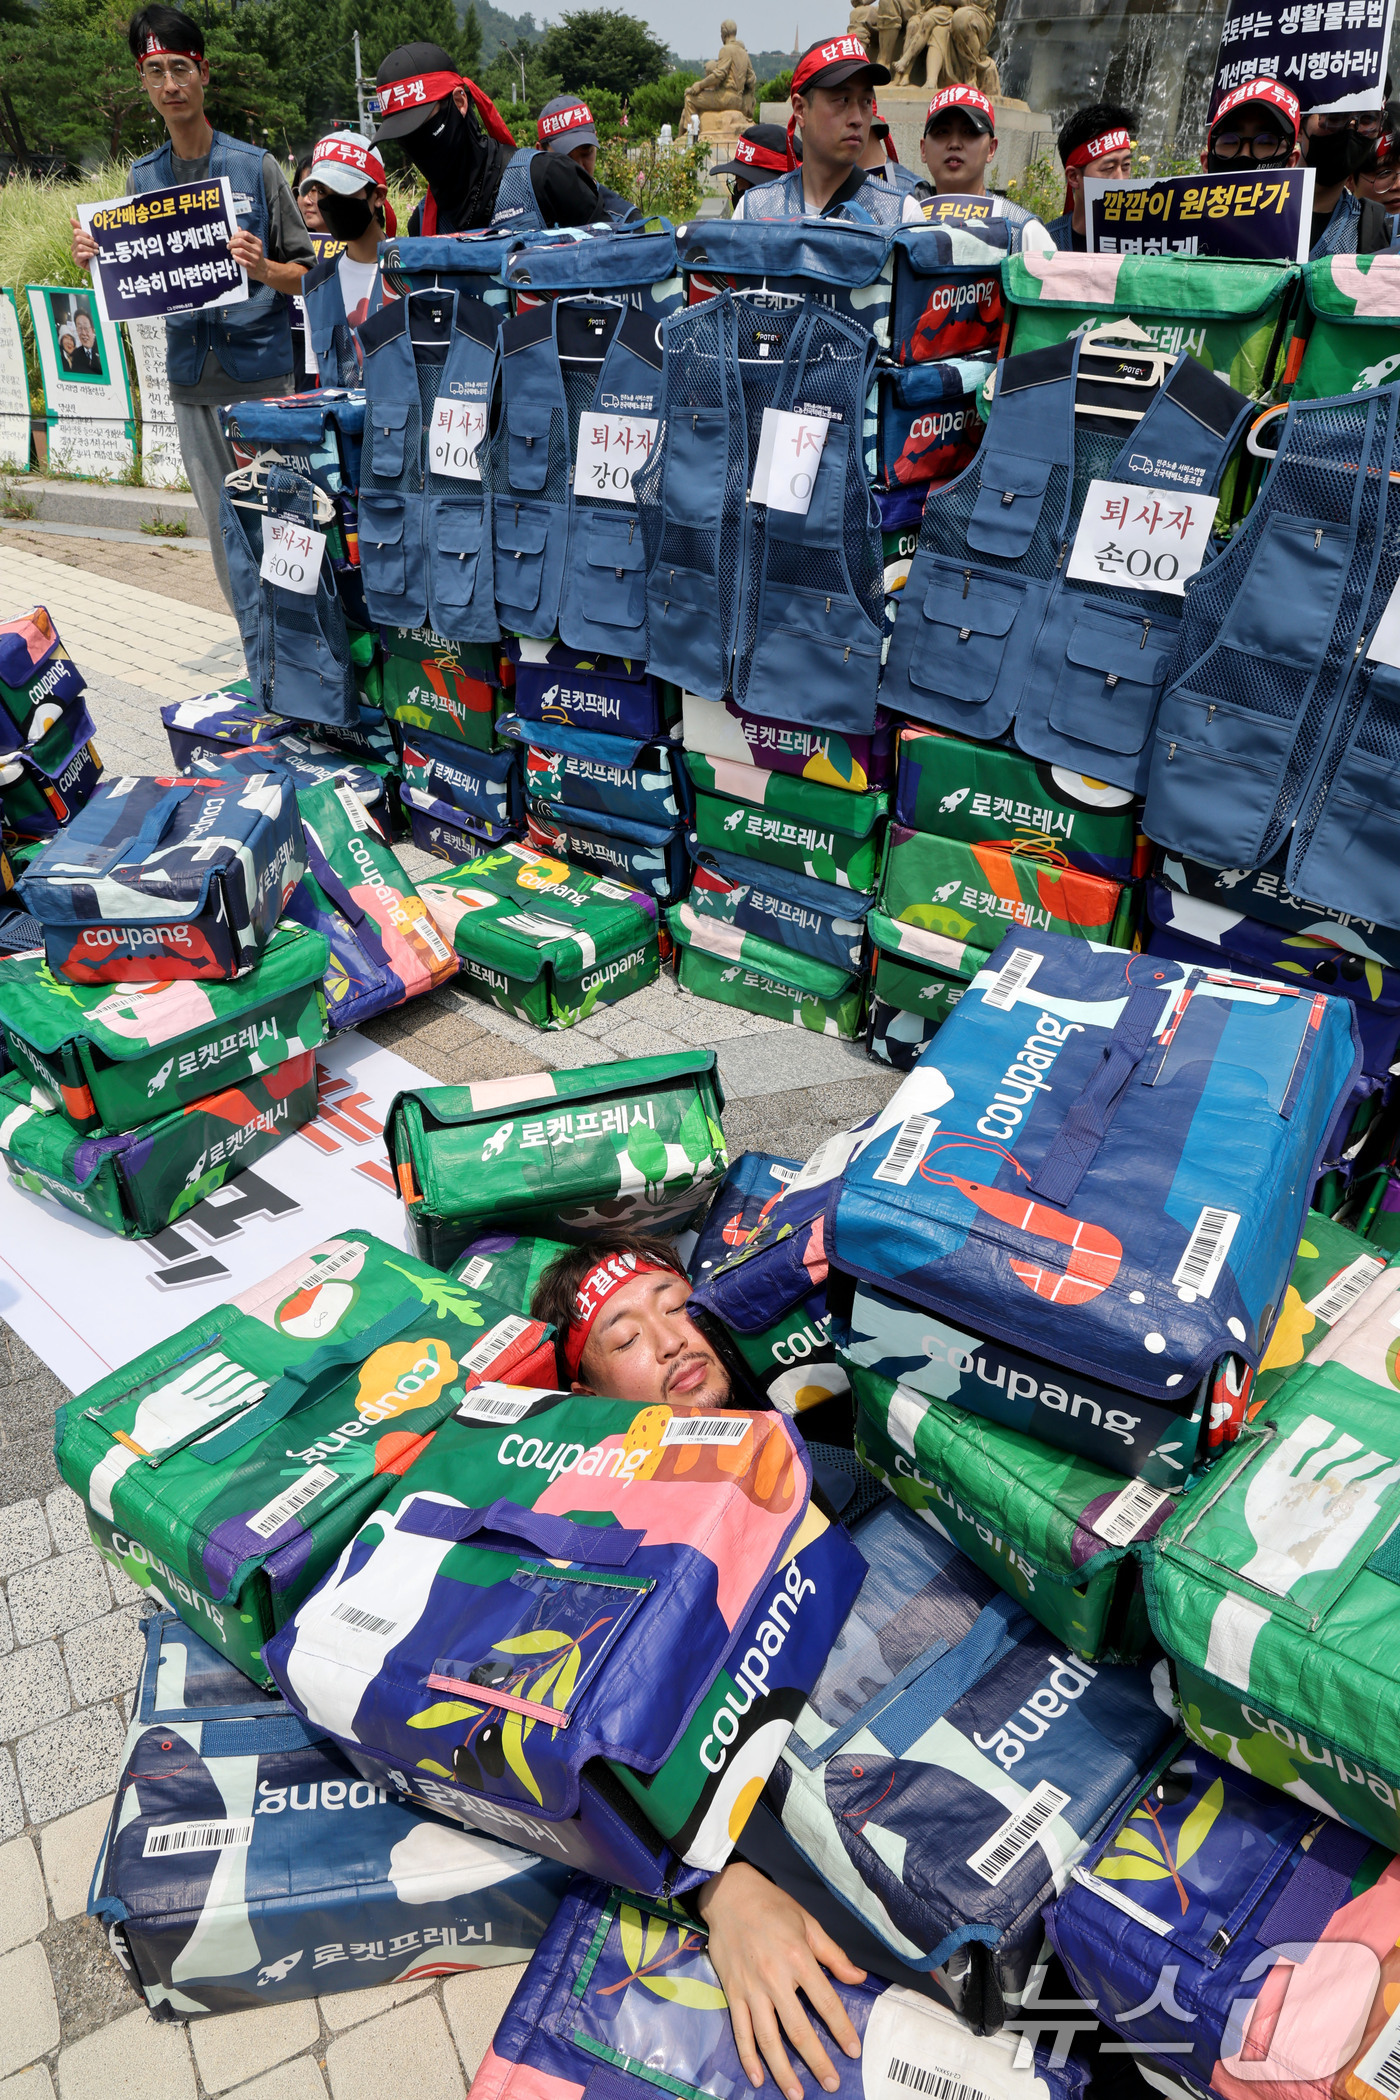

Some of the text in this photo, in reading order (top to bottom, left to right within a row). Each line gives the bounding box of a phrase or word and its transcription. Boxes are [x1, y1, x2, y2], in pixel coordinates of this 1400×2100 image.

[1221, 1, 1383, 46] 국토부는 생활물류법
[821, 40, 855, 62] 단결
[1218, 49, 1378, 90] 개선명령 시행하라!
[393, 80, 426, 106] 투쟁
[929, 88, 990, 113] 단결 투쟁
[1216, 84, 1299, 118] 단결 투쟁
[542, 107, 591, 134] 단결 투쟁
[337, 144, 367, 168] 투쟁
[1087, 131, 1115, 157] 단결
[93, 198, 176, 230] 야간배송으로
[178, 187, 220, 214] 무너진
[1103, 180, 1290, 221] 깜깜이 원청단가
[99, 221, 230, 264] 노동자의 생계대책
[117, 258, 239, 299] 신속히 마련하라!
[932, 281, 995, 313] coupang
[437, 408, 485, 438] 퇴사자
[591, 424, 654, 457] 퇴사자
[910, 406, 985, 441] coupang
[1100, 496, 1195, 540] 퇴사자
[271, 526, 313, 557] 퇴사자
[28, 659, 71, 705] coupang
[420, 690, 466, 721] 로켓프레시
[560, 689, 621, 720] 로켓프레시
[744, 722, 830, 760] 로켓프레시
[59, 745, 92, 793] coupang
[434, 762, 480, 796] 로켓프레시
[565, 757, 637, 790] 로켓프레시
[745, 814, 835, 855] 로켓프레시
[969, 793, 1075, 839] 로켓프레시
[570, 837, 630, 872] 로켓프레시
[347, 837, 410, 927] coupang
[518, 872, 590, 908] coupang
[749, 890, 822, 935] 로켓프레시
[959, 886, 1052, 932] 로켓프레시
[83, 924, 192, 951] coupang
[580, 946, 646, 992] coupang
[9, 1030, 63, 1102] coupang
[178, 1016, 279, 1078] 로켓프레시
[976, 1011, 1086, 1140] coupang
[209, 1097, 289, 1168] 로켓프레시
[519, 1101, 656, 1149] 로켓프레시
[575, 1266, 618, 1322] 단결
[921, 1334, 1142, 1445] coupang
[285, 1357, 441, 1467] coupang
[496, 1433, 652, 1488] coupang
[110, 1532, 230, 1643] coupang
[700, 1557, 816, 1774] coupang
[313, 1920, 494, 1970] 로켓프레시
